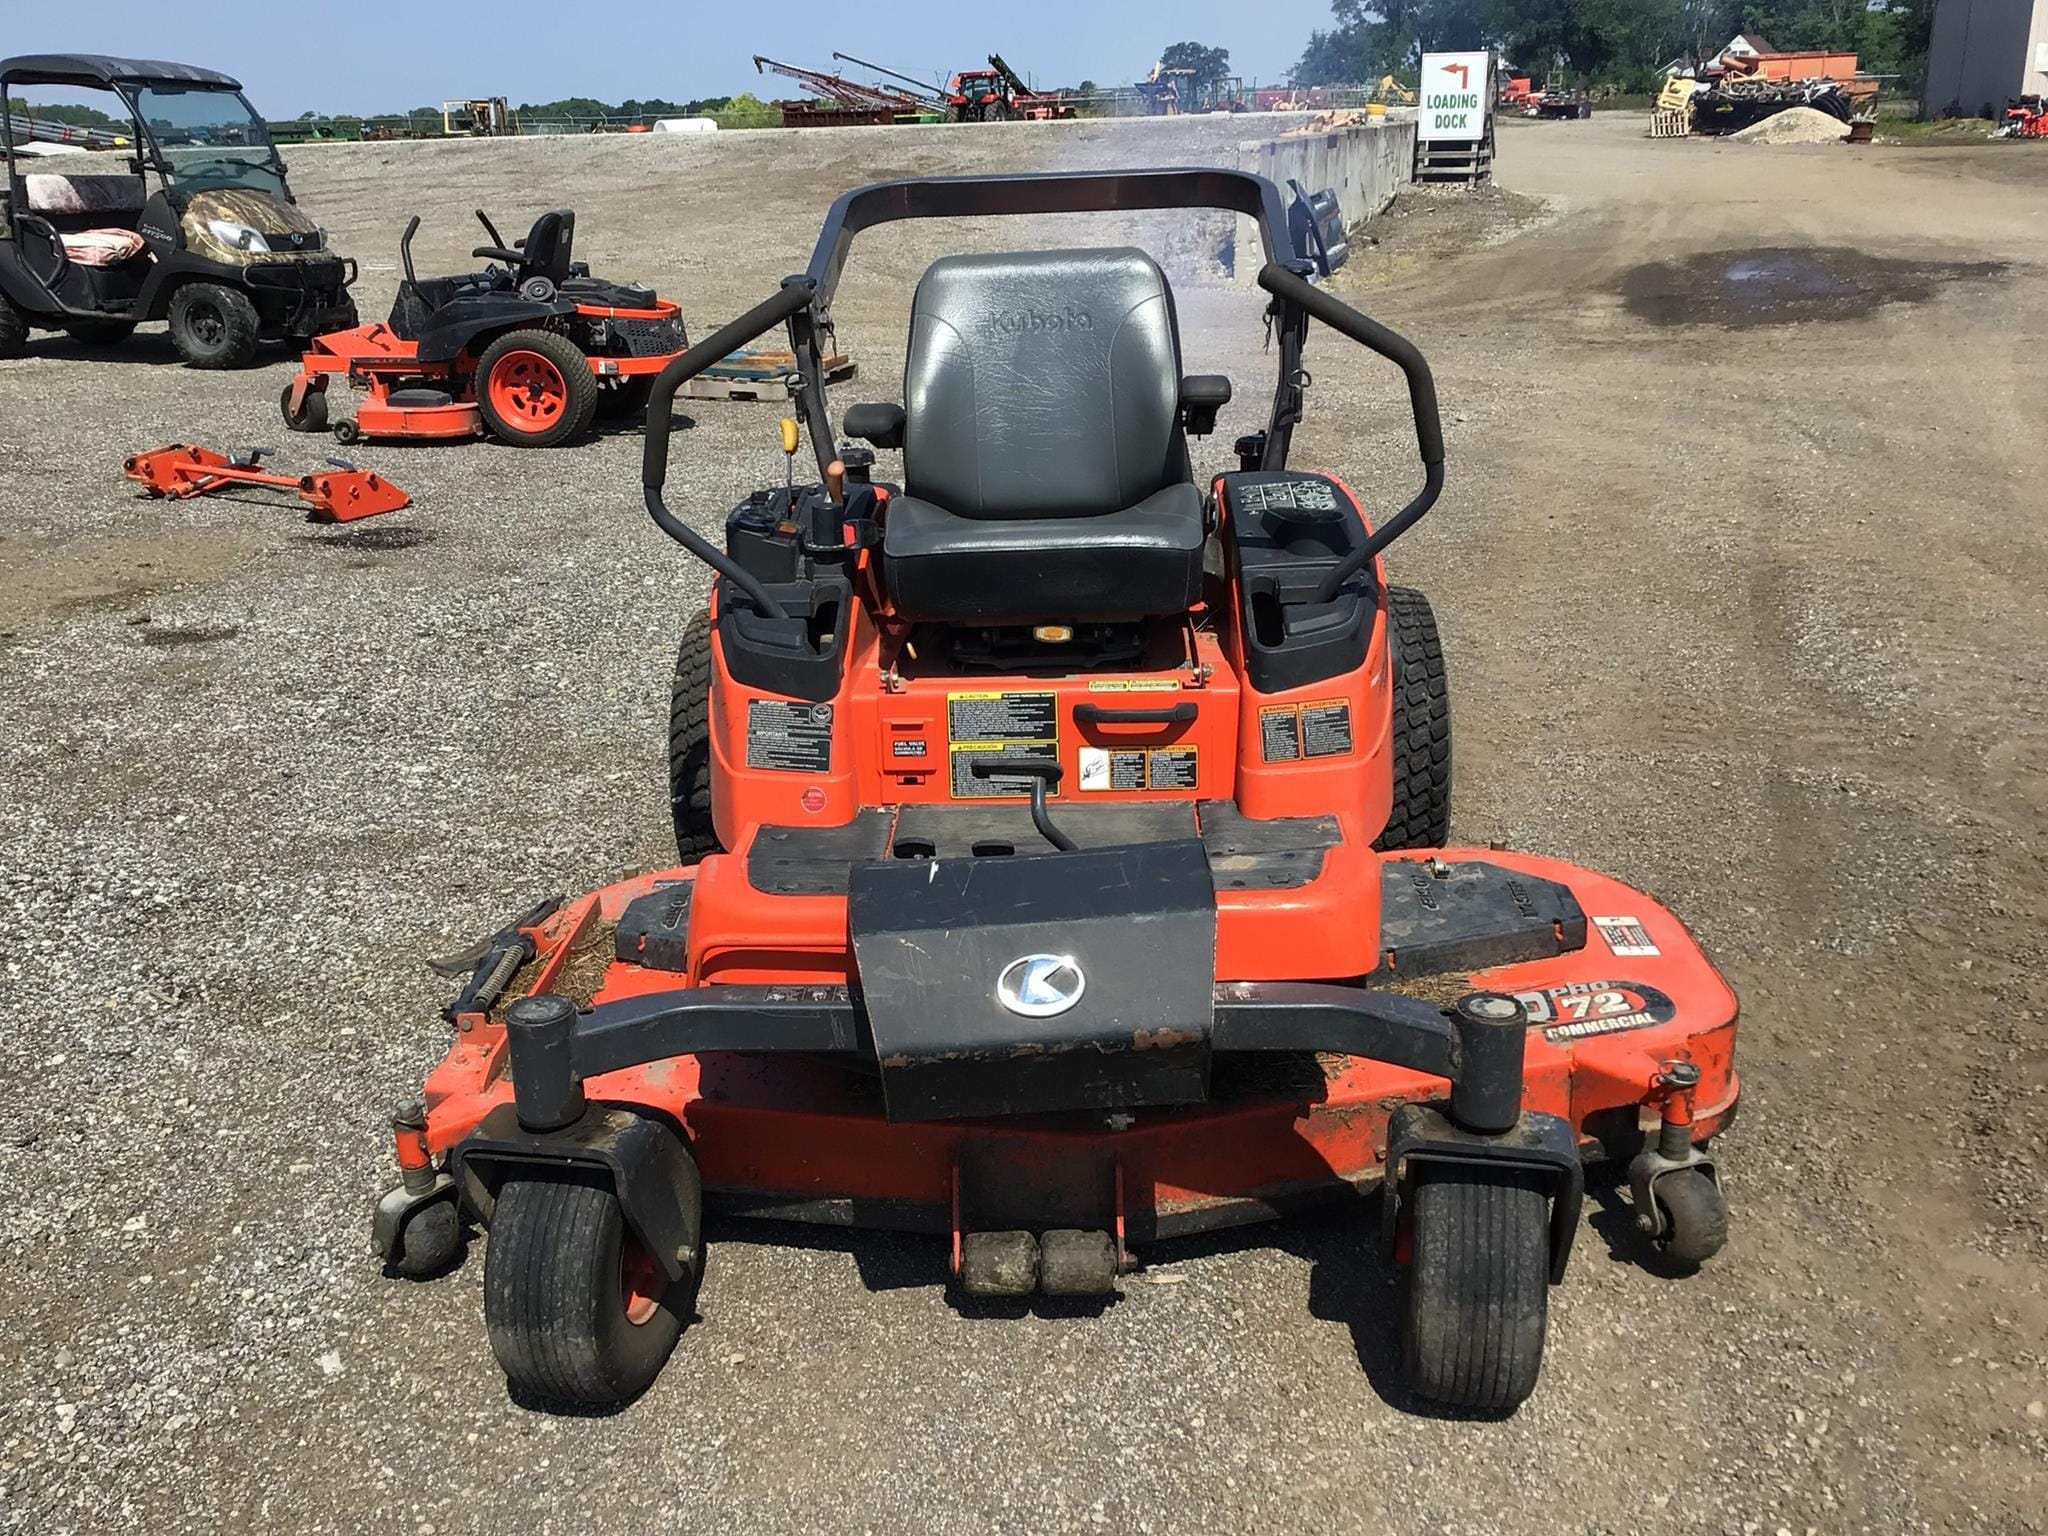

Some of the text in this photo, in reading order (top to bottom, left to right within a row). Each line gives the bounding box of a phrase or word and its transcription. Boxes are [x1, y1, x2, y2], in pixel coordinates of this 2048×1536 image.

[1427, 94, 1478, 109] LOADING
[1435, 114, 1468, 129] DOCK
[988, 305, 1094, 336] Kubota
[1550, 980, 1610, 999] PRO
[1561, 992, 1632, 1019] 72
[1546, 1012, 1657, 1040] COMMERCIAL
